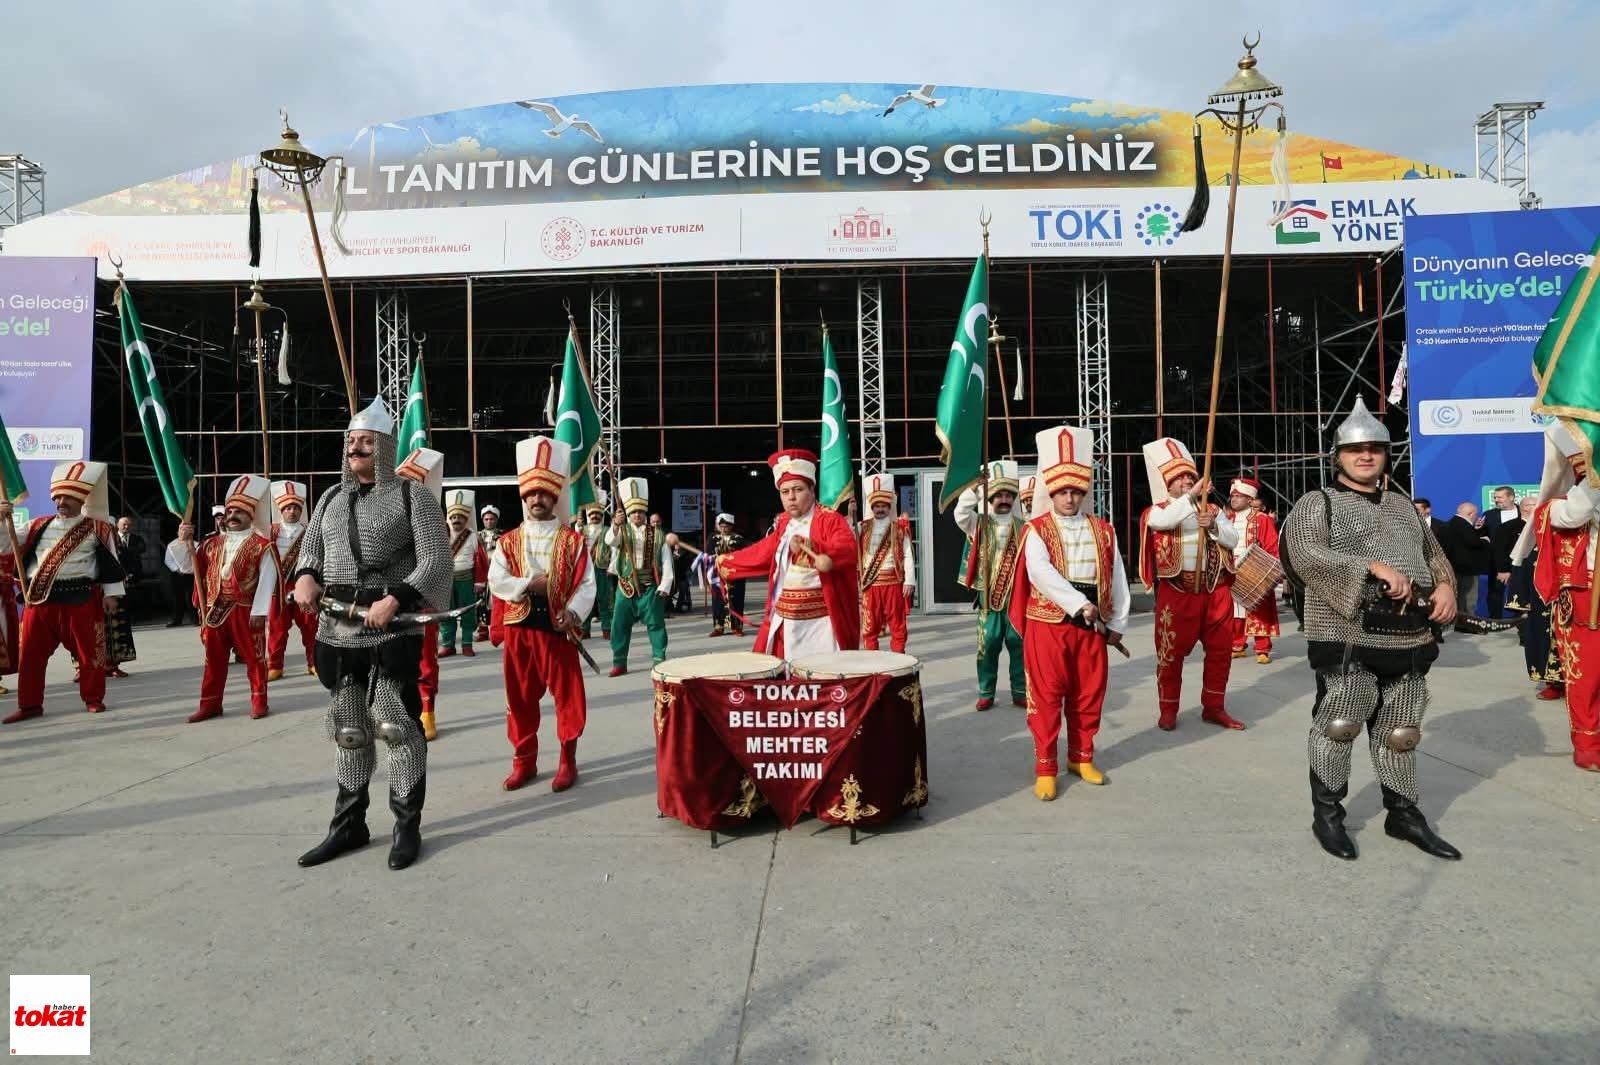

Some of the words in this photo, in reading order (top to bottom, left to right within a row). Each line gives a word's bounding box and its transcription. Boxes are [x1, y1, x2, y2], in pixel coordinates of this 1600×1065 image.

[380, 159, 553, 193] TANITIM
[567, 141, 821, 186] GÜNLERİNE
[837, 145, 931, 183] HOŞ
[943, 134, 1157, 173] GELDİNİZ
[1331, 198, 1418, 218] EMLAK
[591, 228, 607, 237] T.C.
[610, 226, 648, 237] KÜLTÜR
[651, 226, 663, 234] VE
[666, 224, 705, 234] TURİZM
[1332, 219, 1404, 242] YÖNE
[383, 247, 394, 255] VE
[397, 246, 420, 255] SPOR
[422, 244, 472, 254] BAKANLIĞI
[590, 237, 644, 248] BAKANLIĞI
[1413, 256, 1508, 275] Dünyanın
[1514, 251, 1588, 268] Gelece
[1414, 276, 1561, 304] Türkiye'de!
[10, 294, 89, 313] Geleceği
[1463, 326, 1488, 335] Dünya
[1490, 325, 1502, 334] için
[1470, 336, 1510, 345] Antalya'da
[1511, 335, 1542, 343] buluşuy
[753, 684, 821, 701] TOKAT
[729, 707, 845, 728] BELEDİYESİ
[746, 736, 828, 754] MEHTER
[753, 762, 823, 780] TAKIMI
